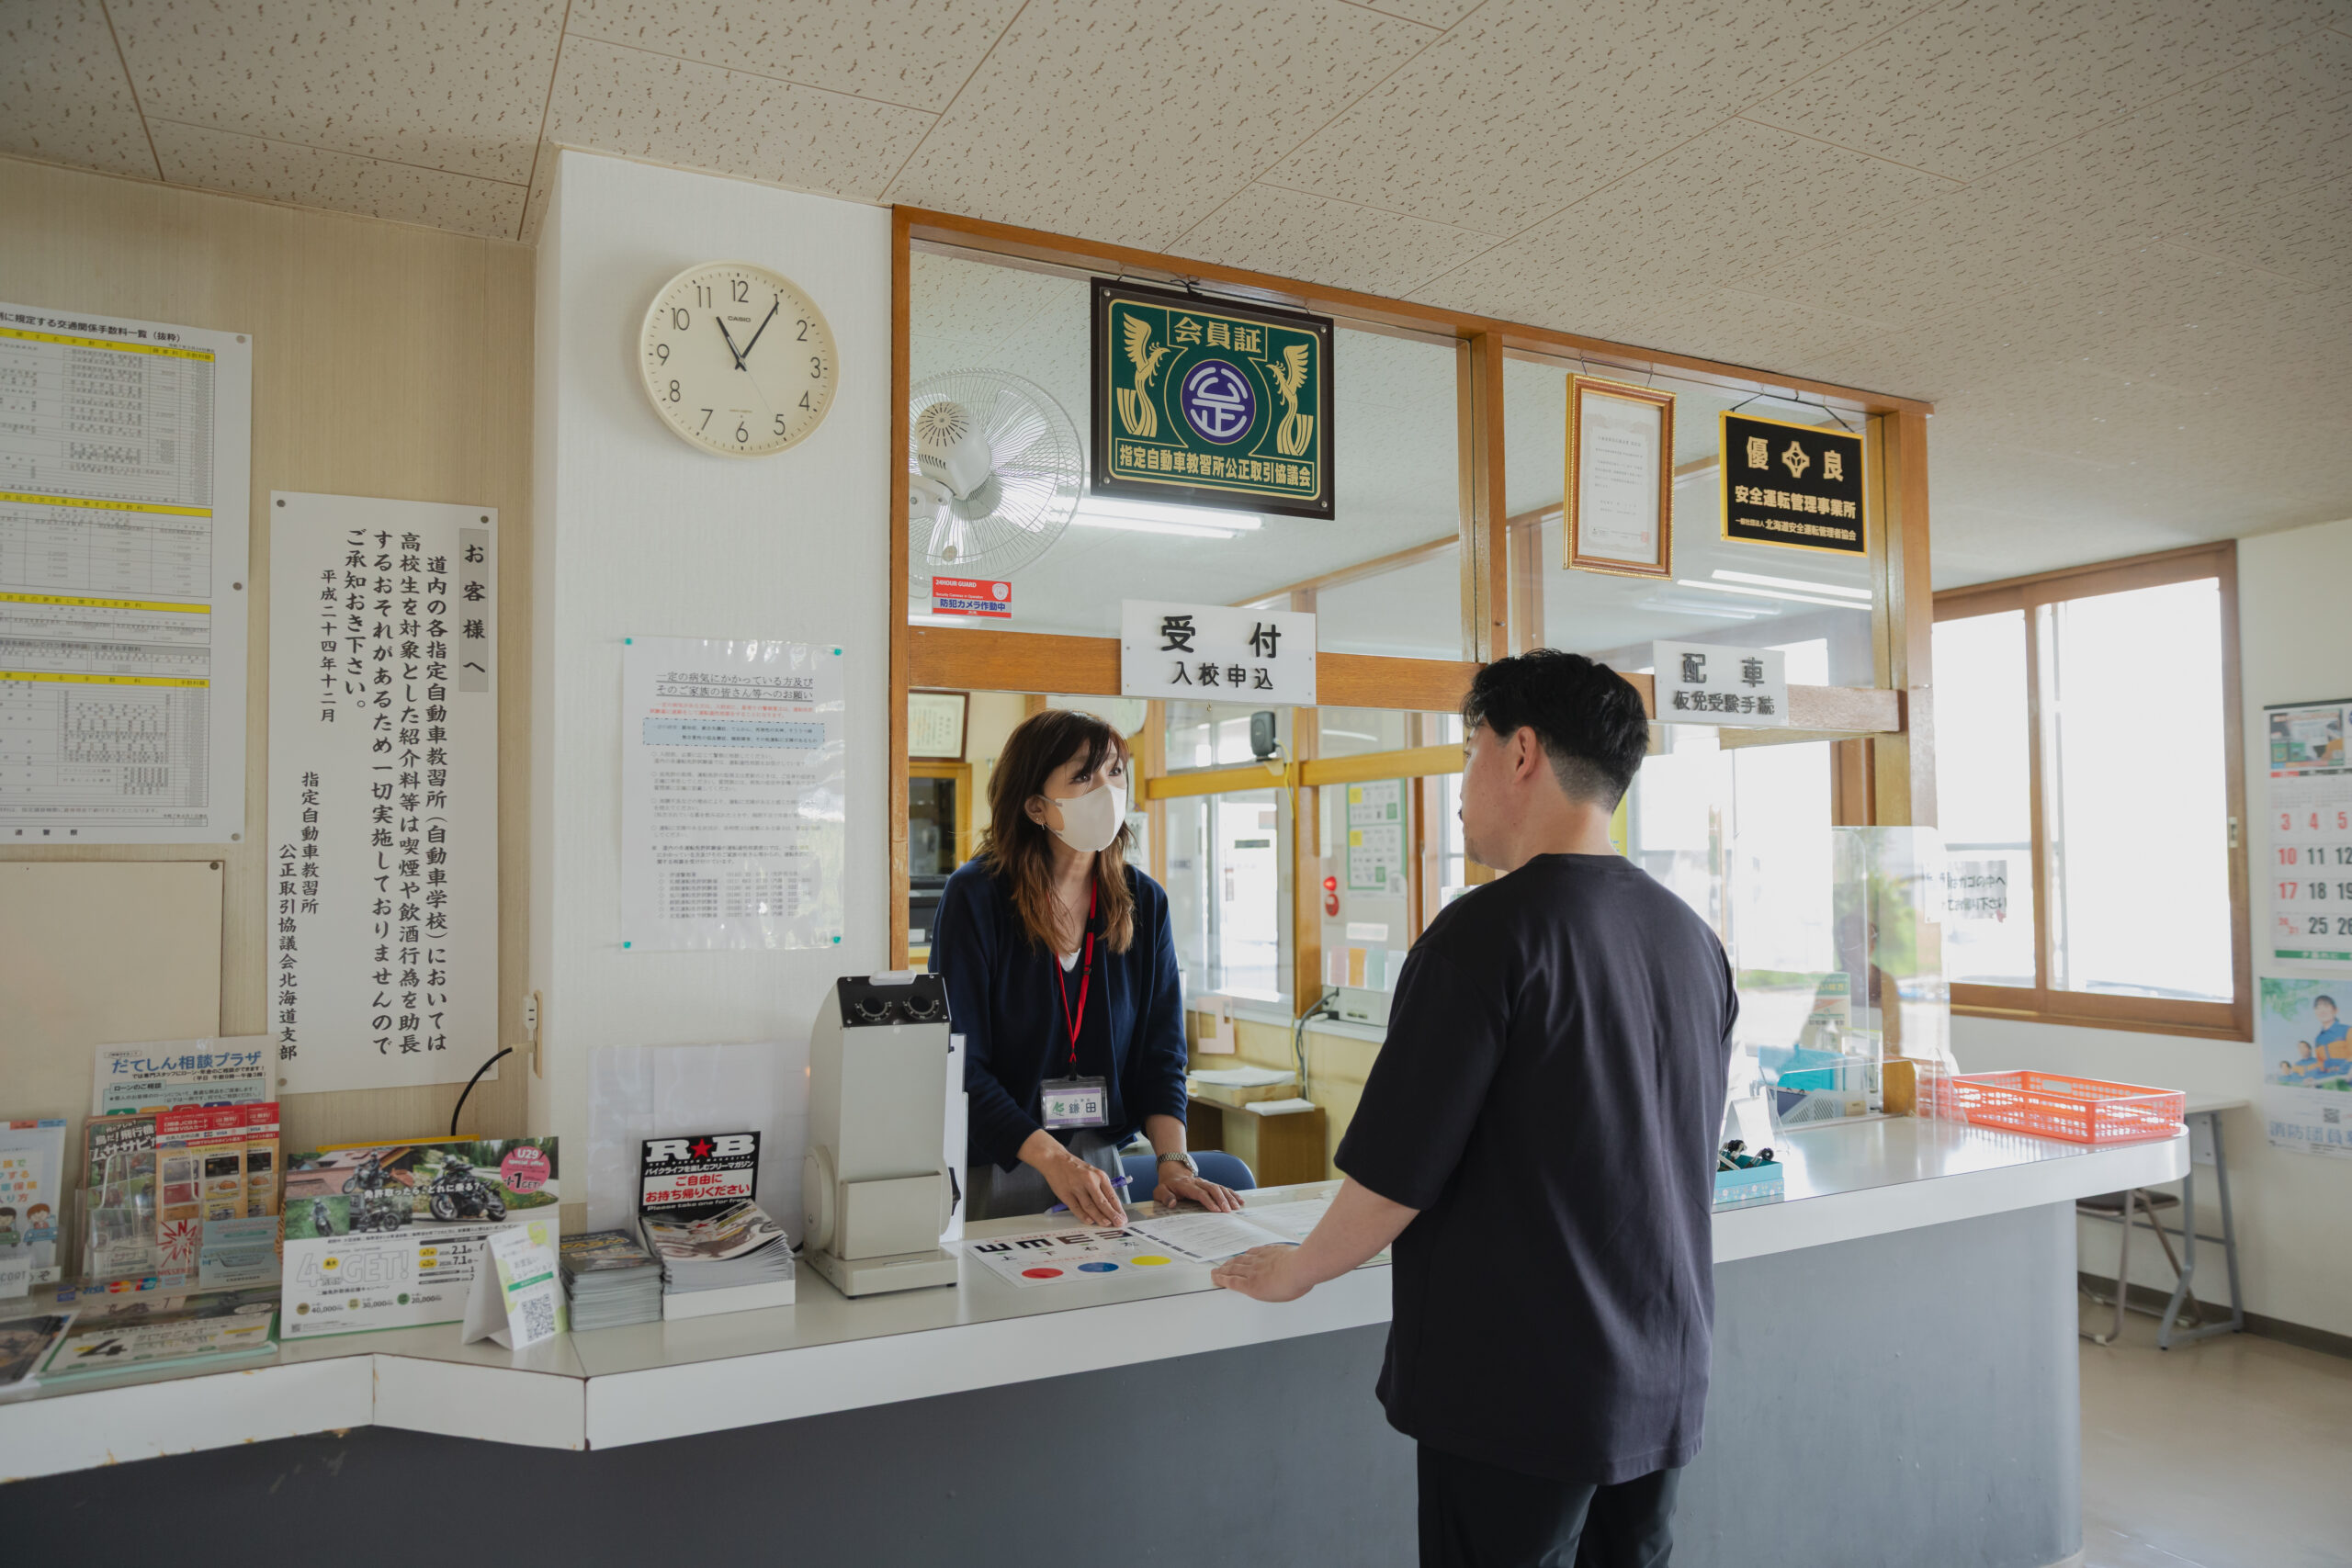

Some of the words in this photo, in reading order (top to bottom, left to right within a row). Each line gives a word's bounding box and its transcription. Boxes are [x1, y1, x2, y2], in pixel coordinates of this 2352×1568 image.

[696, 286, 712, 309] 11
[731, 280, 749, 303] 12
[774, 293, 780, 315] 1
[672, 308, 690, 331] 10
[797, 320, 808, 342] 2
[1173, 315, 1263, 354] 会員証
[656, 344, 670, 367] 9
[810, 356, 821, 378] 3
[669, 379, 681, 402] 8
[798, 390, 810, 412] 4
[700, 409, 714, 431] 7
[773, 413, 786, 435] 5
[736, 421, 749, 443] 6
[1119, 444, 1311, 488] 指定自動車教習所公正取引協議会
[1746, 435, 1770, 471] 優
[1823, 449, 1845, 483] 良
[1734, 484, 1857, 520] 安全運転管理事業所
[462, 543, 486, 673] お客様へ
[939, 598, 1006, 612] 防犯カメラ作動中
[344, 528, 368, 709] ご承知おき下さい。
[320, 569, 338, 723] 平成二十四年十二月
[1161, 614, 1283, 660] 受付
[656, 671, 813, 687] 一定の病気にかかっている方及び
[1171, 660, 1274, 692] 入校申込
[1682, 652, 1765, 688] 配車
[657, 684, 813, 700] そのご家族の皆さん等へのお願い
[371, 529, 394, 1055] するおそれがあるため一切実施しておりませんので
[398, 531, 422, 1055] 高校生を対象とした紹介料等は喫煙や飲酒行為を助長
[425, 555, 448, 1052] 道内の各指定自動車教習所（自動車学校）においては
[2280, 813, 2291, 830] 3
[2309, 812, 2319, 830] 4
[2337, 811, 2348, 829] 5
[300, 771, 321, 915] 指定自動車教習所
[2278, 847, 2298, 865] 10
[2307, 847, 2326, 865] 11
[2278, 882, 2299, 900] 17
[2309, 882, 2327, 900] 18
[2309, 917, 2329, 935] 25
[278, 843, 298, 1061] 公正取引協議会北海道支部
[111, 1050, 263, 1075] だてしん相談プラザ
[114, 1082, 162, 1091] ローンのご相談
[516, 1148, 539, 1159] U29
[675, 1173, 723, 1187] ご自由に
[645, 1184, 750, 1202] お持ち帰りください
